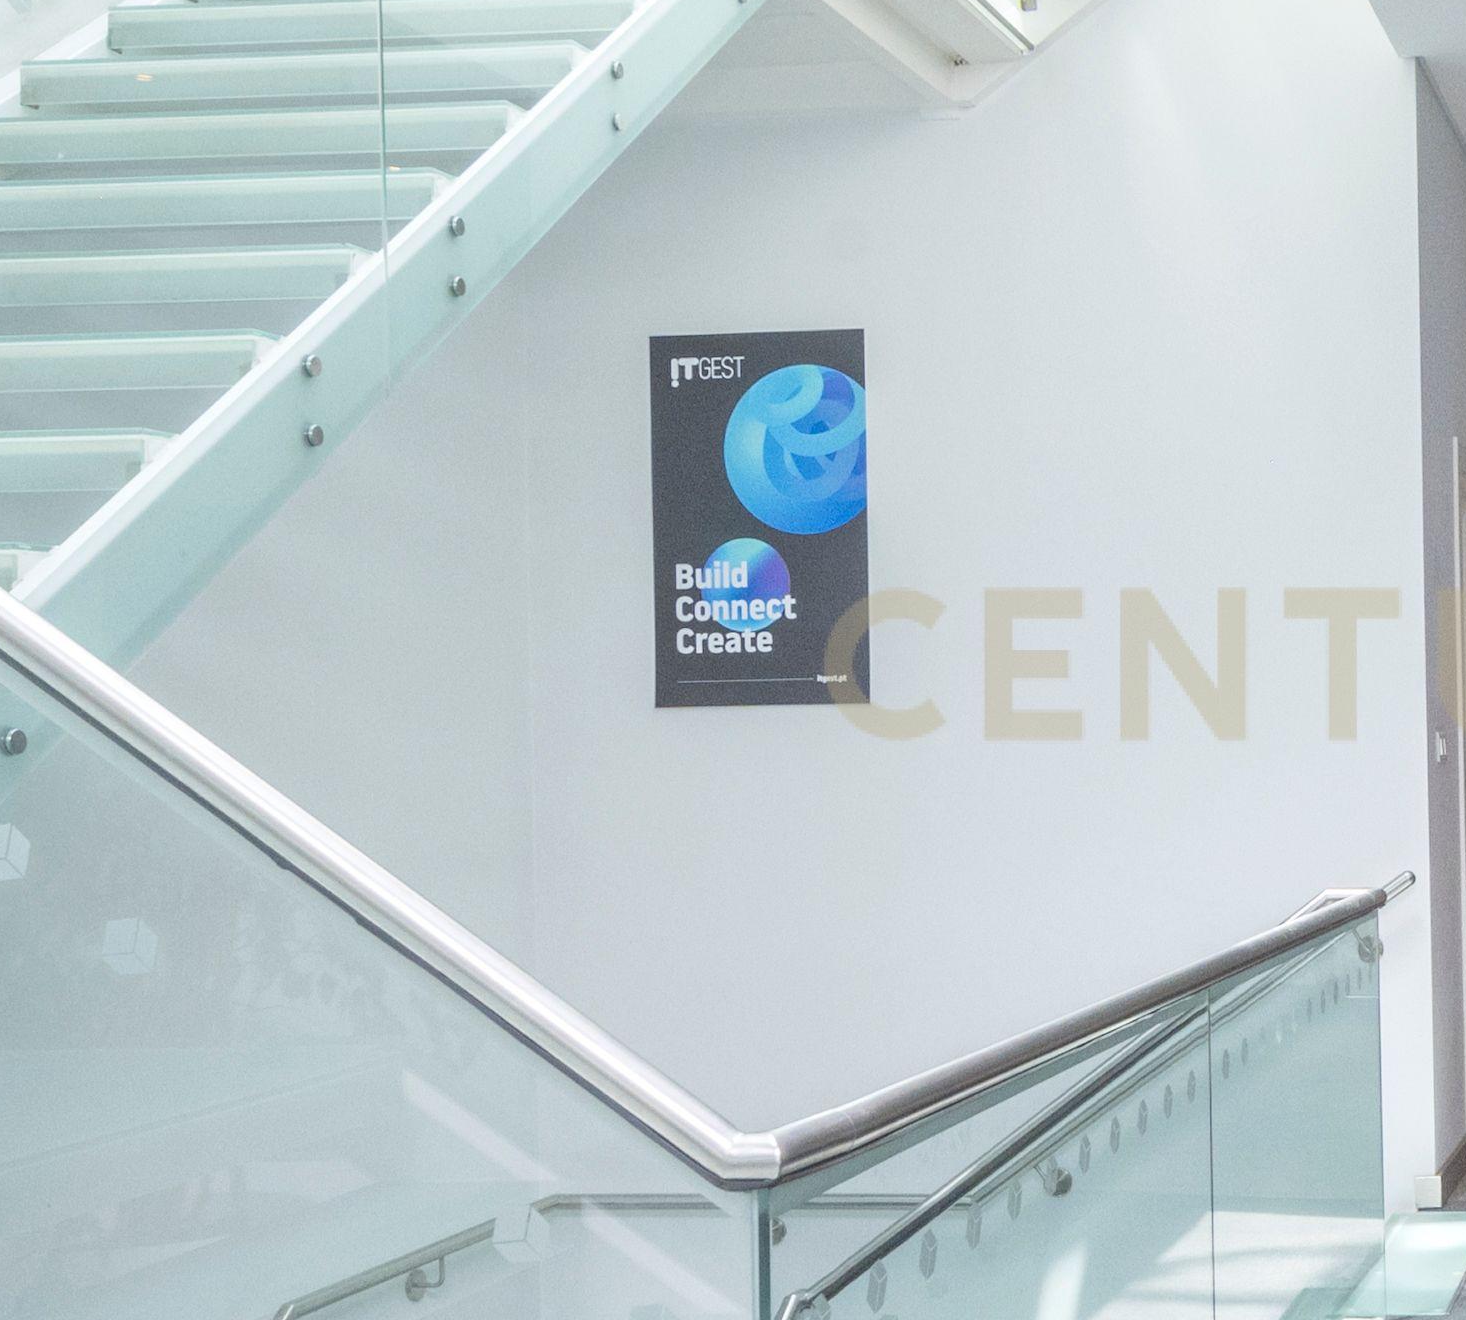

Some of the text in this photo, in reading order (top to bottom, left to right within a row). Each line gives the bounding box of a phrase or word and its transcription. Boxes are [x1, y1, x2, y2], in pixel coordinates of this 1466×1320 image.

[675, 561, 748, 591] Build
[675, 594, 797, 623] Connect
[676, 628, 774, 655] Create
